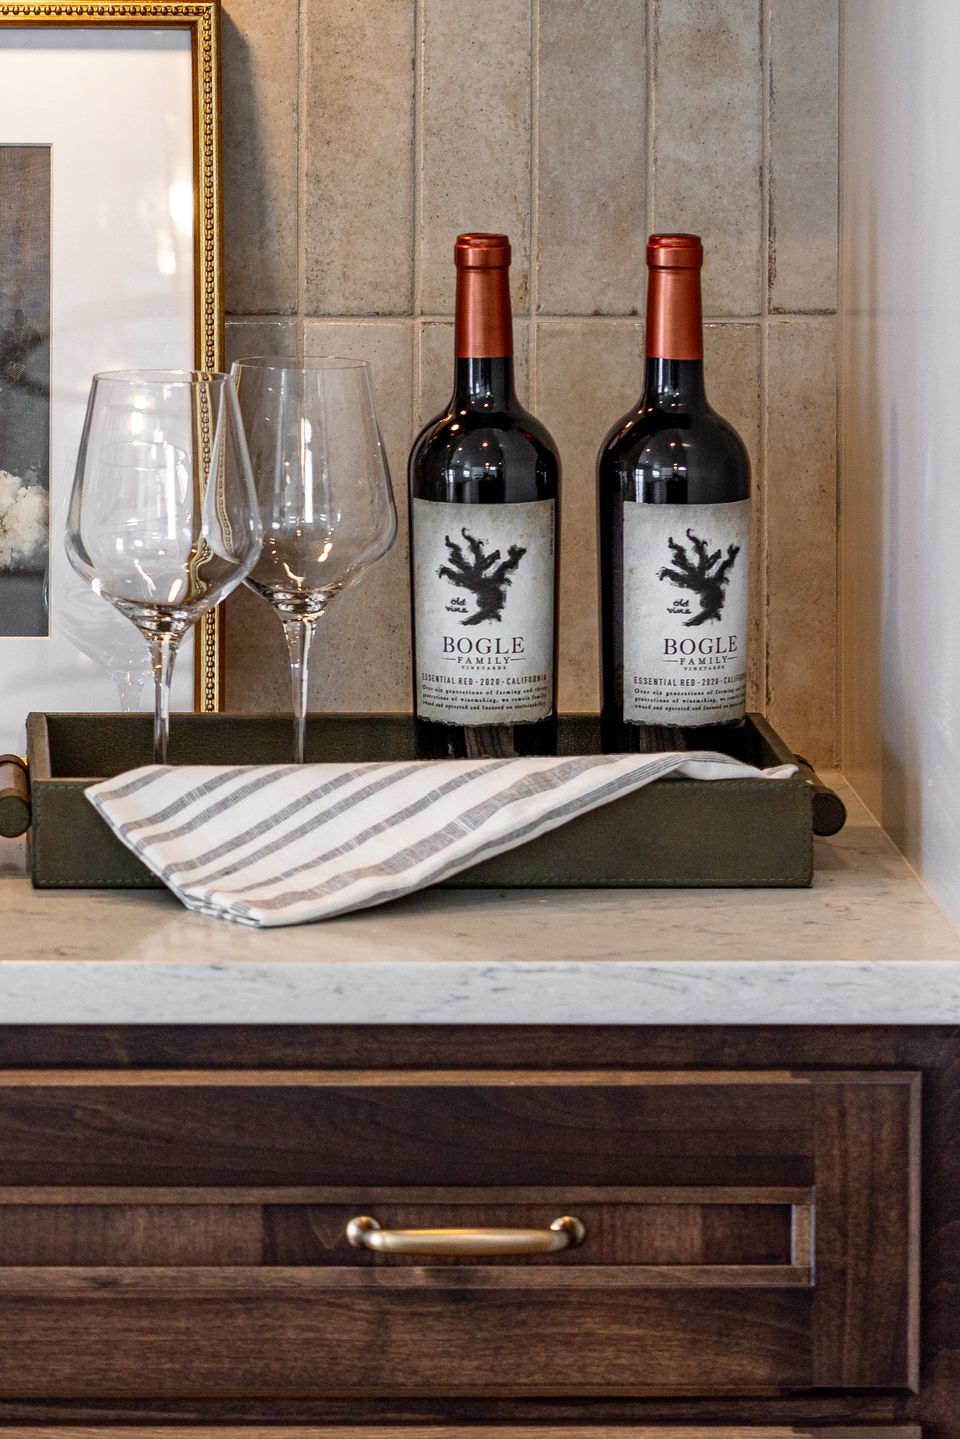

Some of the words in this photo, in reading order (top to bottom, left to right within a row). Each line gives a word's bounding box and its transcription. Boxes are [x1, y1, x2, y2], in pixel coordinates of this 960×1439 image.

[673, 598, 690, 606] old
[442, 636, 525, 654] BOGLE
[663, 635, 738, 656] BOGLE
[458, 656, 510, 664] FAMILY
[680, 656, 728, 665] FAMILY
[422, 672, 456, 684] ESSENTIAL
[458, 678, 473, 686] RED
[506, 674, 546, 685] CALIFORNIA
[634, 676, 677, 687] ESSENTIAL
[680, 678, 696, 686] RED
[702, 678, 719, 686] 2020
